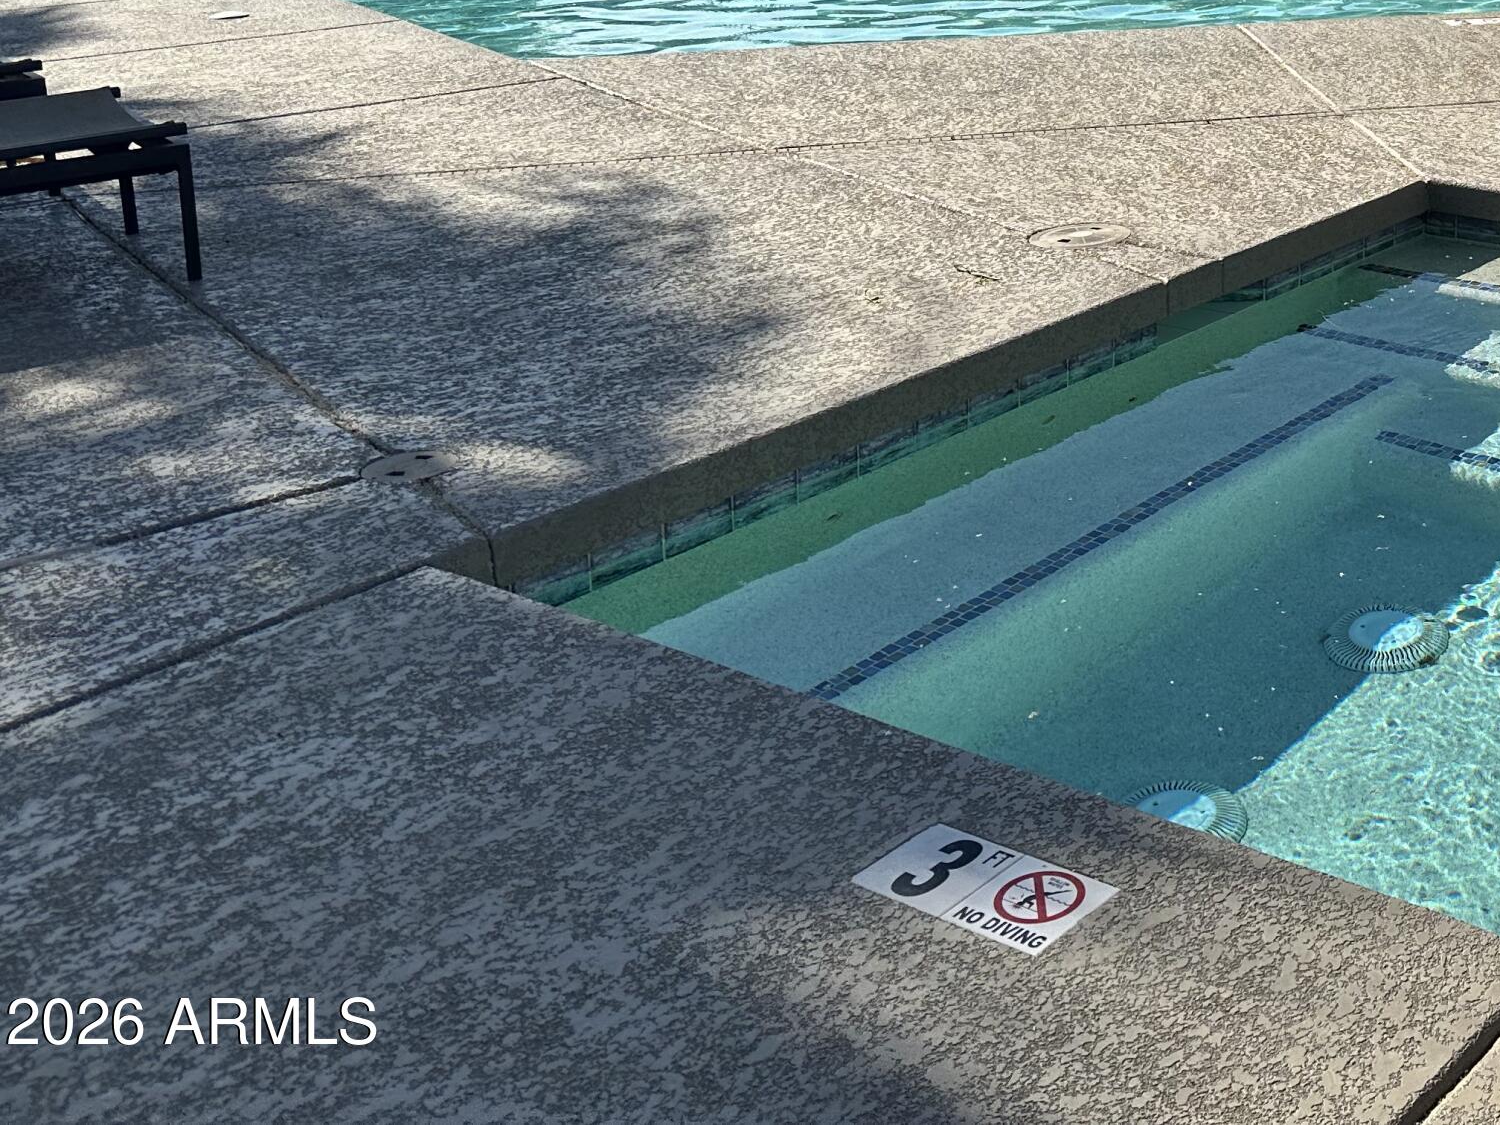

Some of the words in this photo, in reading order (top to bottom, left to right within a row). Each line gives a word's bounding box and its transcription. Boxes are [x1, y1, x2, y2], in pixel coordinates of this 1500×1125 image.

[890, 839, 984, 897] 3
[983, 850, 1015, 868] FT
[953, 906, 984, 924] NO
[981, 917, 1048, 949] DIVING
